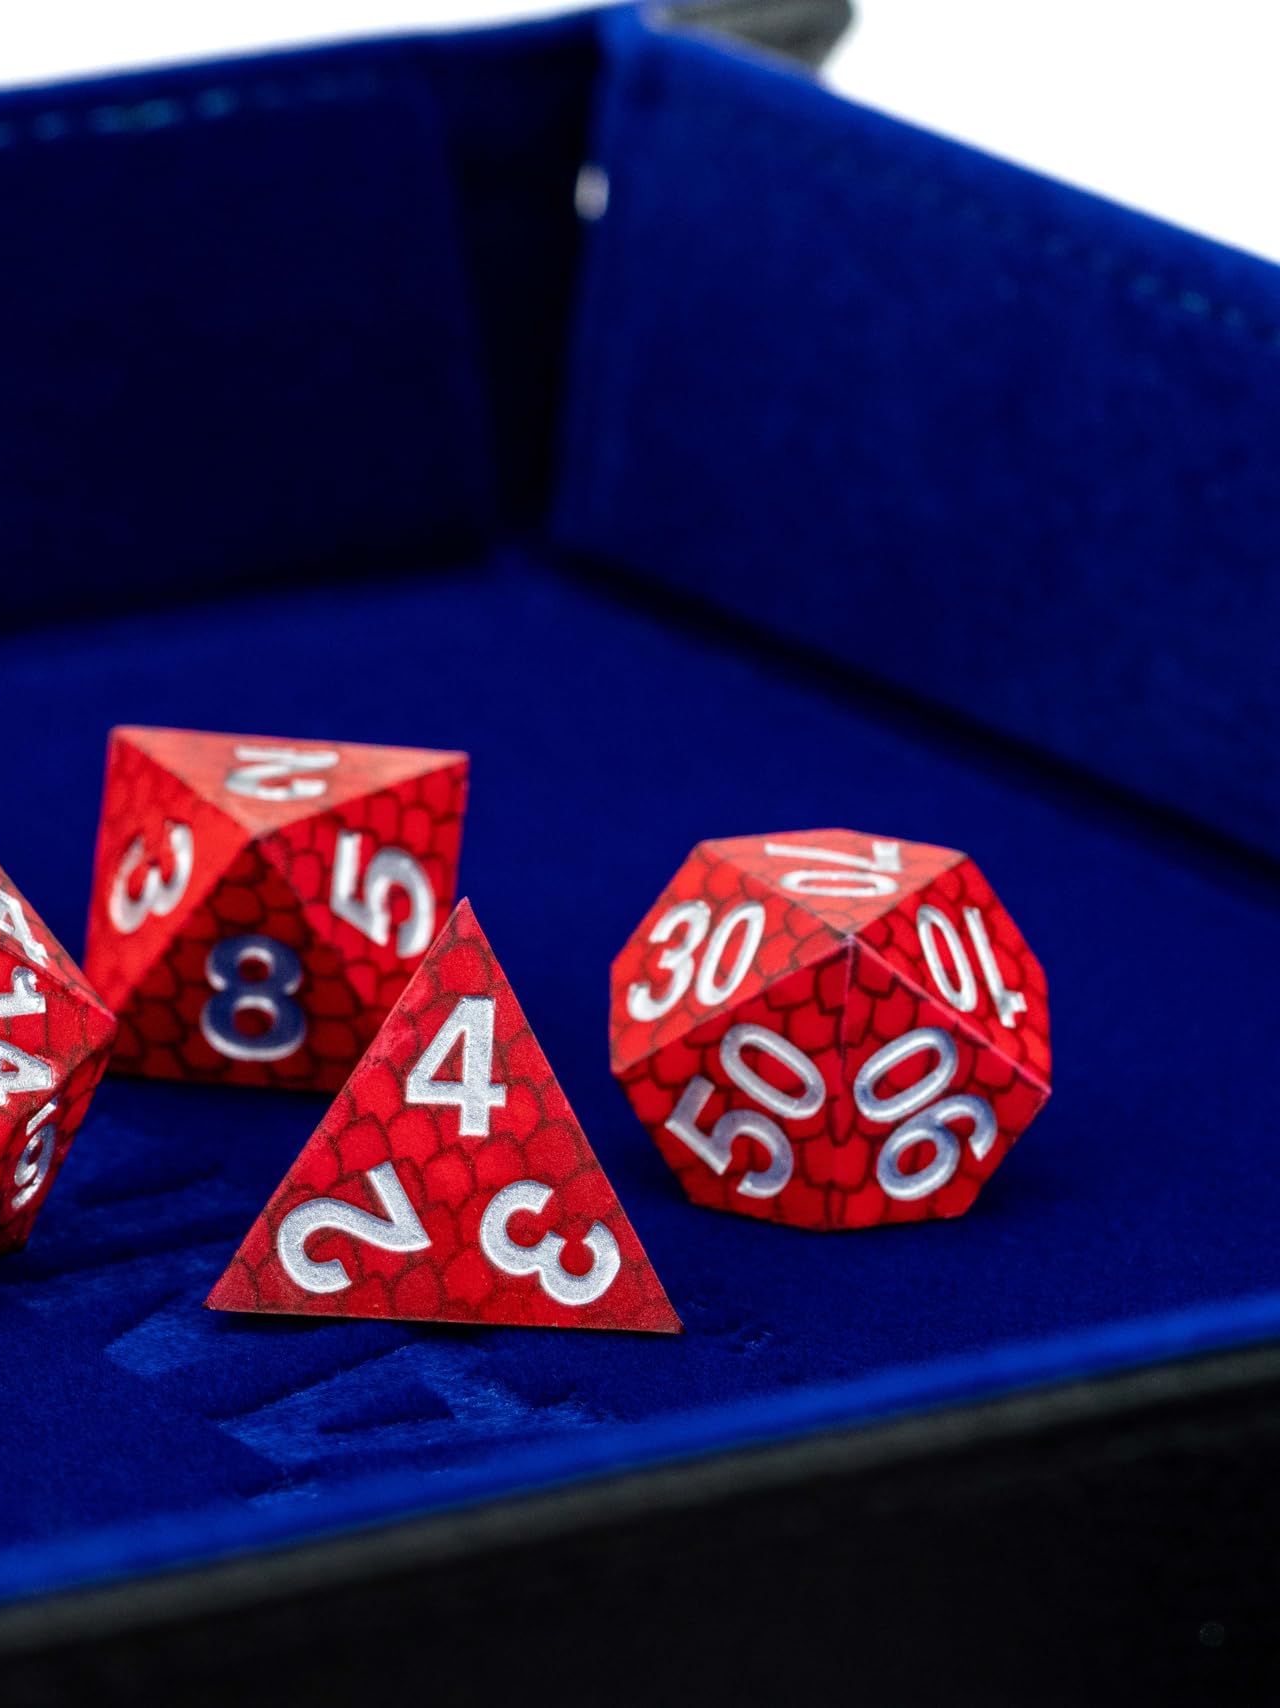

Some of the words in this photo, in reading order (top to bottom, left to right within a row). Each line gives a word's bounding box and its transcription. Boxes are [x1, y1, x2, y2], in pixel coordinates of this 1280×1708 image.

[223, 745, 339, 801] 2
[109, 818, 194, 935] 3
[330, 830, 436, 960] 5
[763, 841, 903, 897] 70
[200, 933, 308, 1063] 8
[626, 900, 766, 1022] 30
[918, 904, 1028, 1029] 10
[406, 995, 506, 1137] 4
[665, 1023, 827, 1199] 50
[276, 1161, 432, 1294] 2
[480, 1179, 621, 1306] 3
